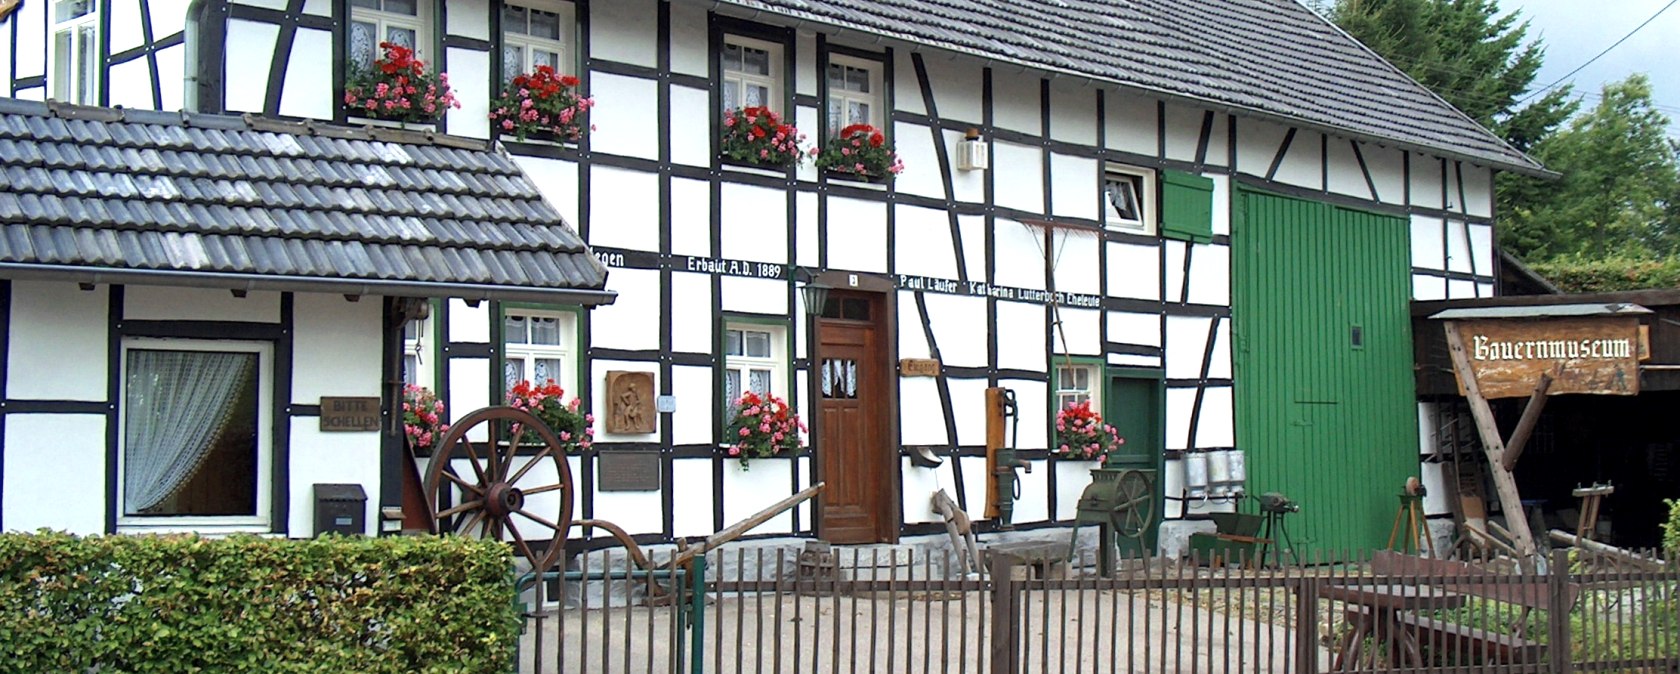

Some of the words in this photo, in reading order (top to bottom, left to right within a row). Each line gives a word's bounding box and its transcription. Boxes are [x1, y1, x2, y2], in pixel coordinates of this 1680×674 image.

[687, 256, 726, 273] Erbaut
[729, 260, 753, 276] A.D.
[756, 263, 781, 279] 1889
[900, 274, 925, 290] Paul
[969, 282, 1014, 299] Katharina
[1472, 335, 1631, 361] Bauernmuseum
[333, 400, 368, 411] BITTE
[323, 416, 379, 428] SCHELLEN
